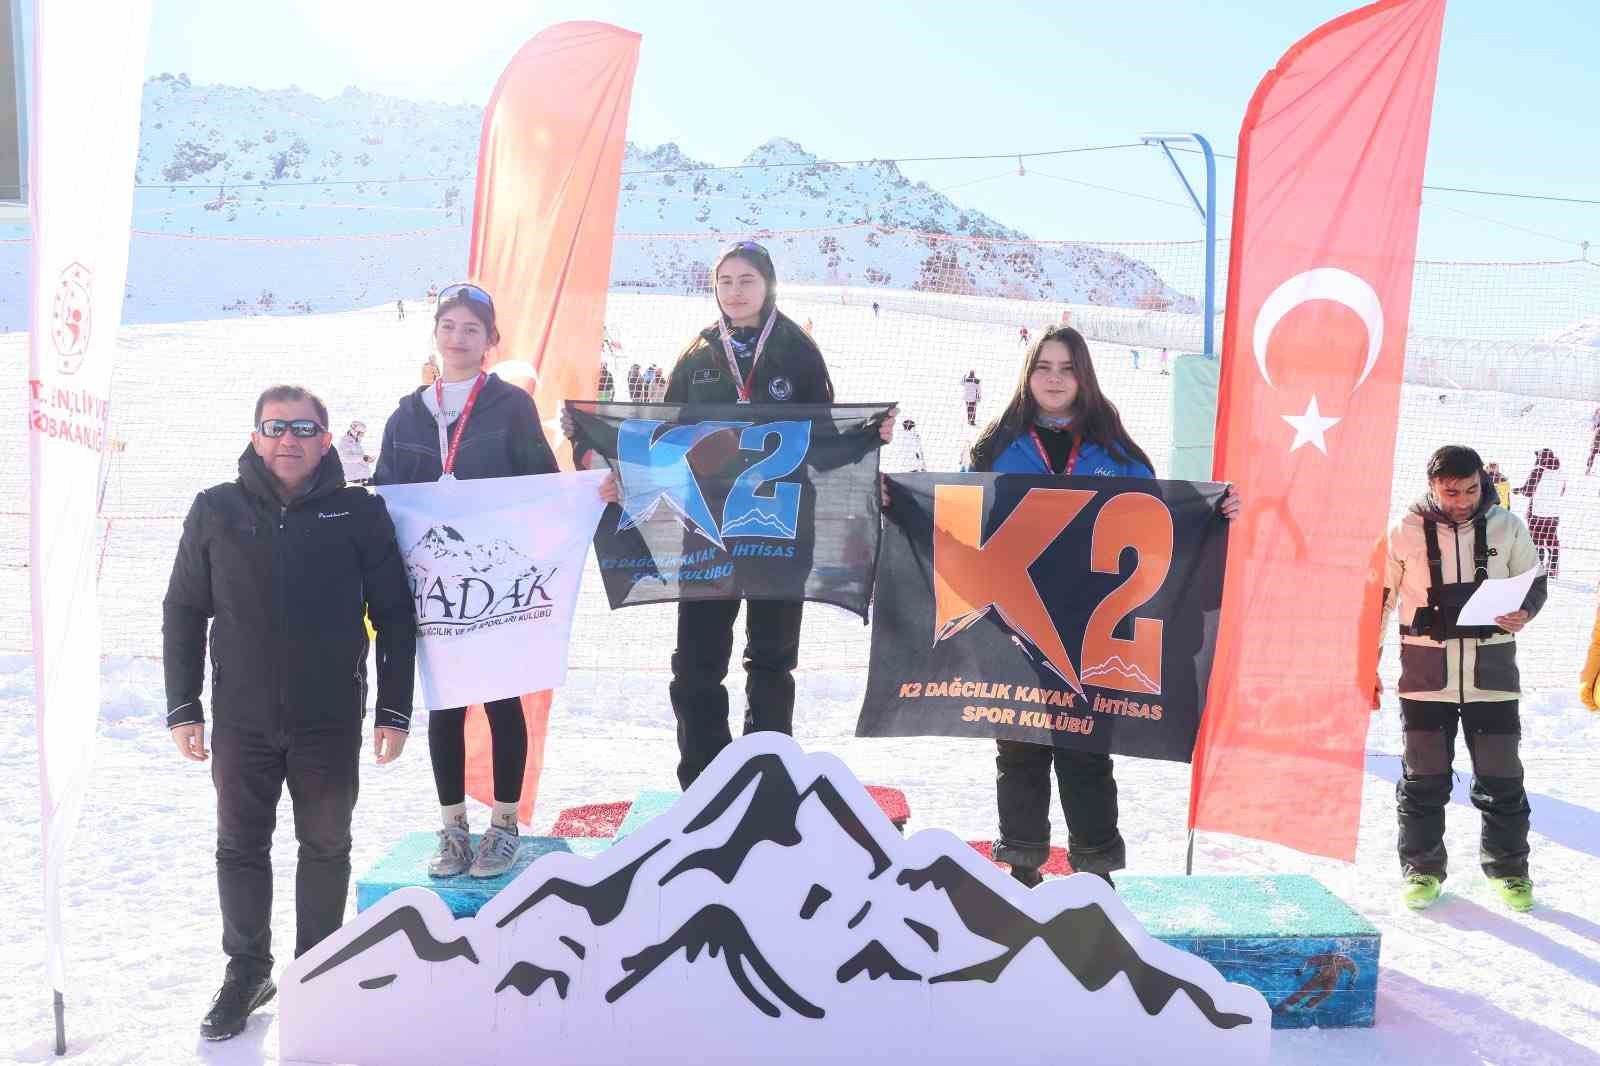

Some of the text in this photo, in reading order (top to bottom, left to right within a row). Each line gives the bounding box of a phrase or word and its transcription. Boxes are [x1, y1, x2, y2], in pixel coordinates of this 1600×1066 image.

[616, 419, 812, 552] K2
[933, 485, 1174, 703] K2
[899, 677, 1164, 721] K2 DAĞCILIK KAYAK İHTİSAS
[962, 705, 1096, 736] SPOR KULÜBÜ
